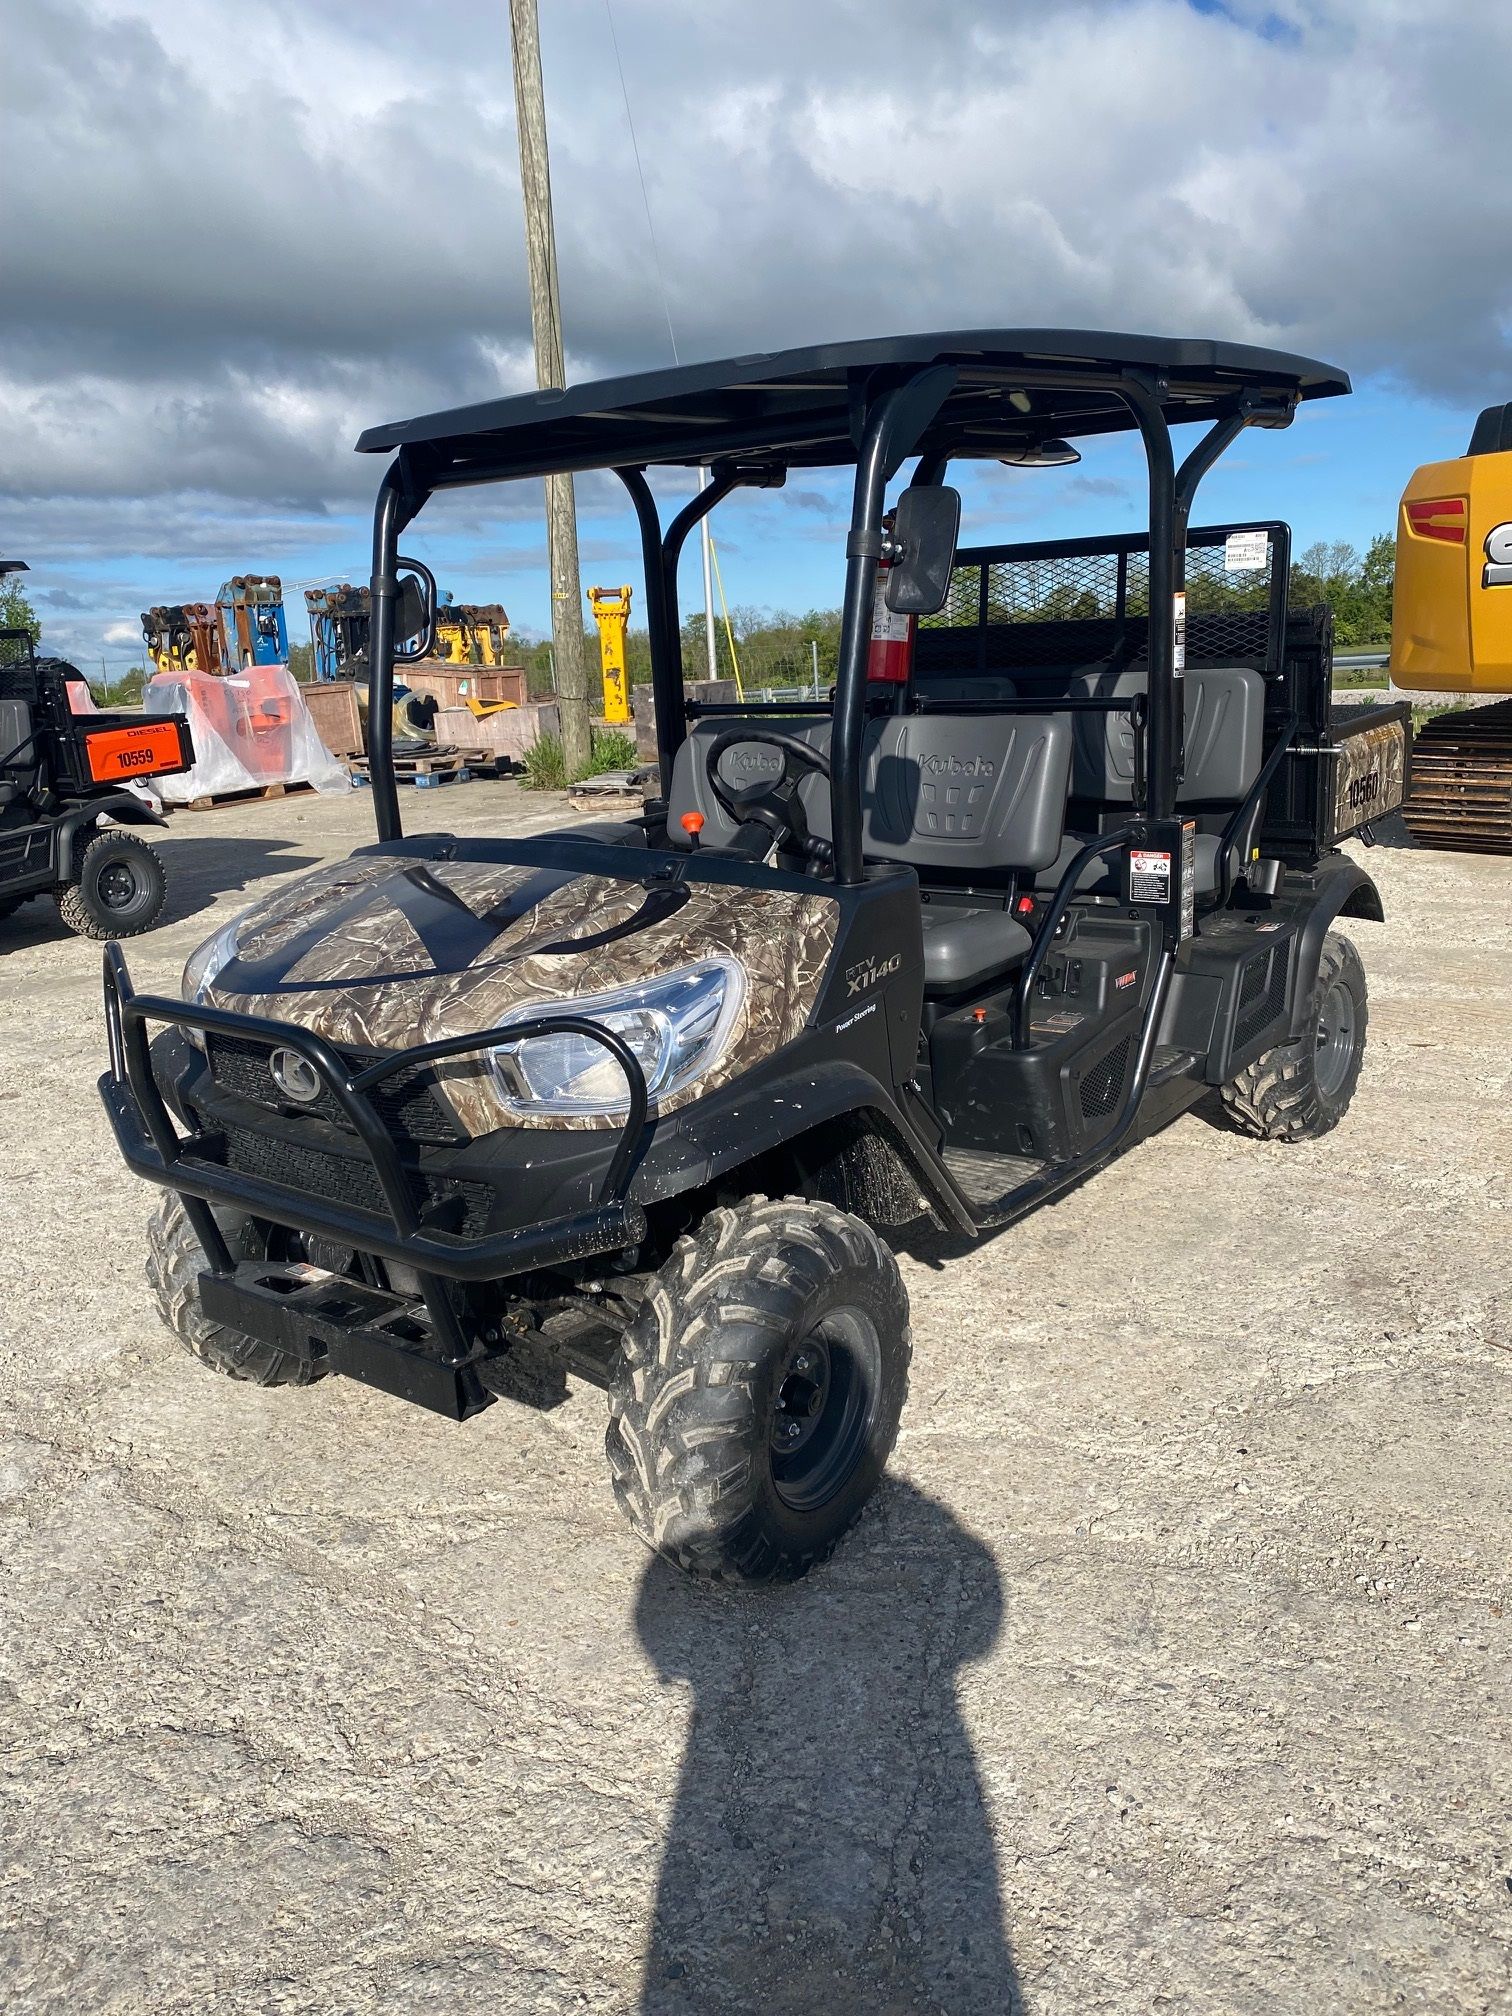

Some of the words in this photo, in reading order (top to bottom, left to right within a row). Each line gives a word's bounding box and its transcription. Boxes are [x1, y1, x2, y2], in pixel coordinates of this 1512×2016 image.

[127, 726, 171, 737] DIESEL
[117, 748, 154, 768] 10559
[917, 753, 995, 777] Kubota
[1347, 771, 1379, 810] 10560
[846, 955, 875, 980] RTV
[846, 953, 902, 998] X1140
[835, 1018, 854, 1033] Power
[853, 1003, 877, 1022] Steering
